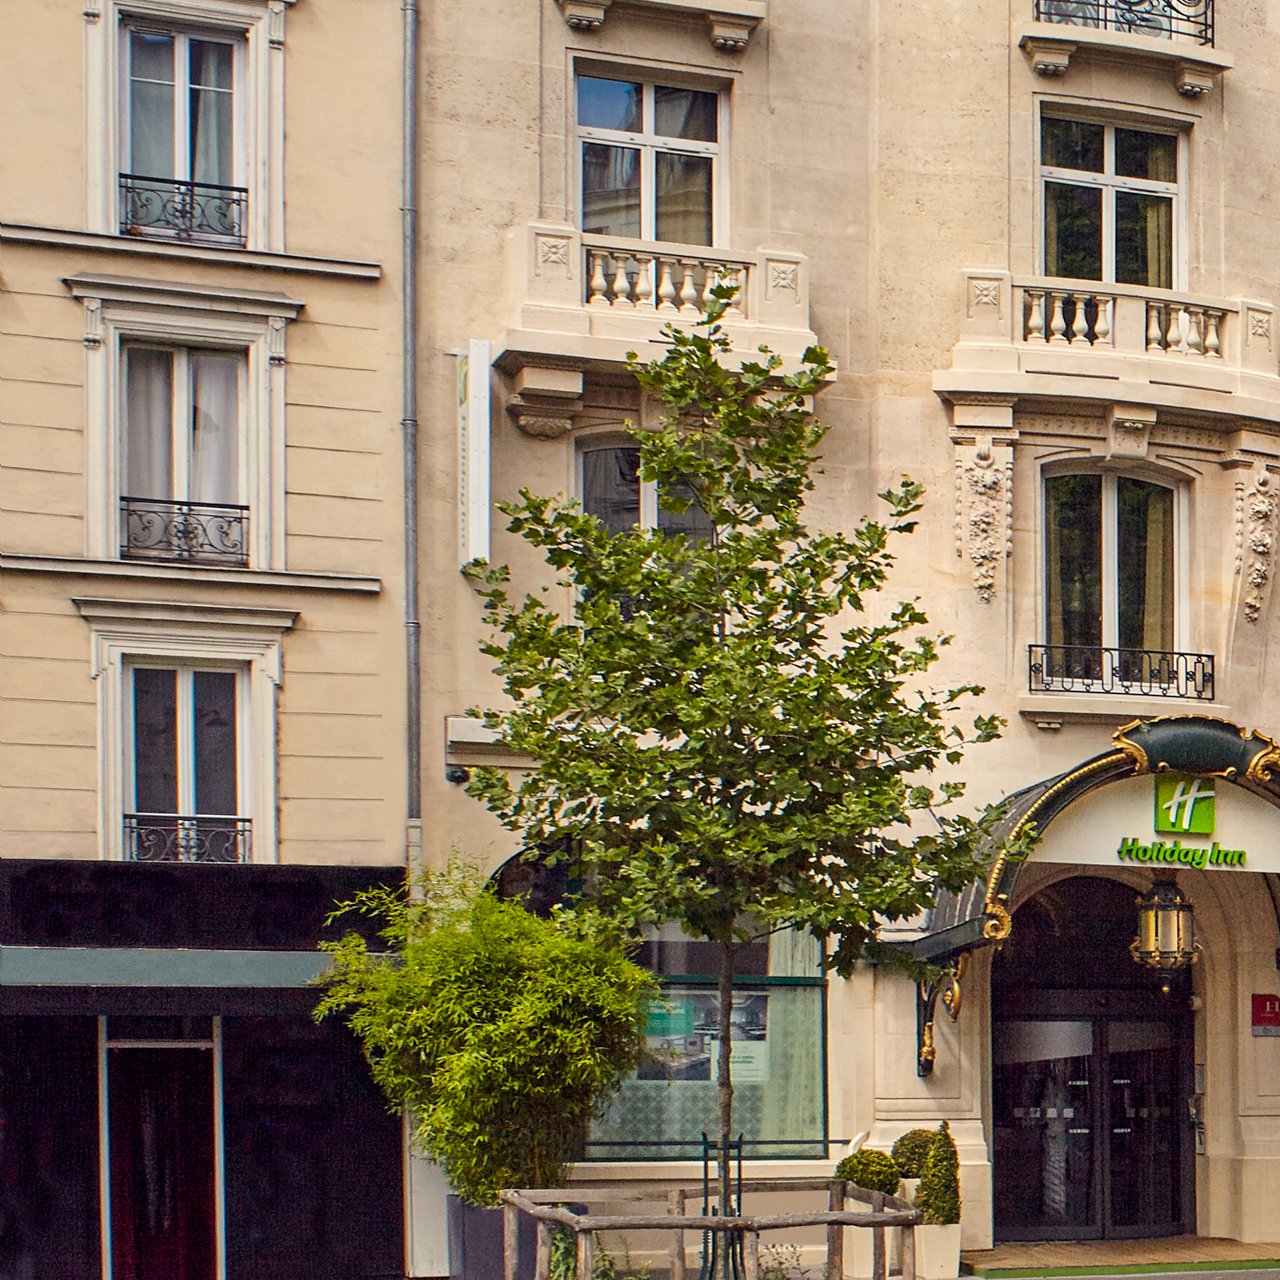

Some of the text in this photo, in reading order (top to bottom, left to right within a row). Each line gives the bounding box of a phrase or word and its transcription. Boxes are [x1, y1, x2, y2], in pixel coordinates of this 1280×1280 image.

[1117, 837, 1247, 869] Holiday Inn
[1265, 1001, 1279, 1012] H
